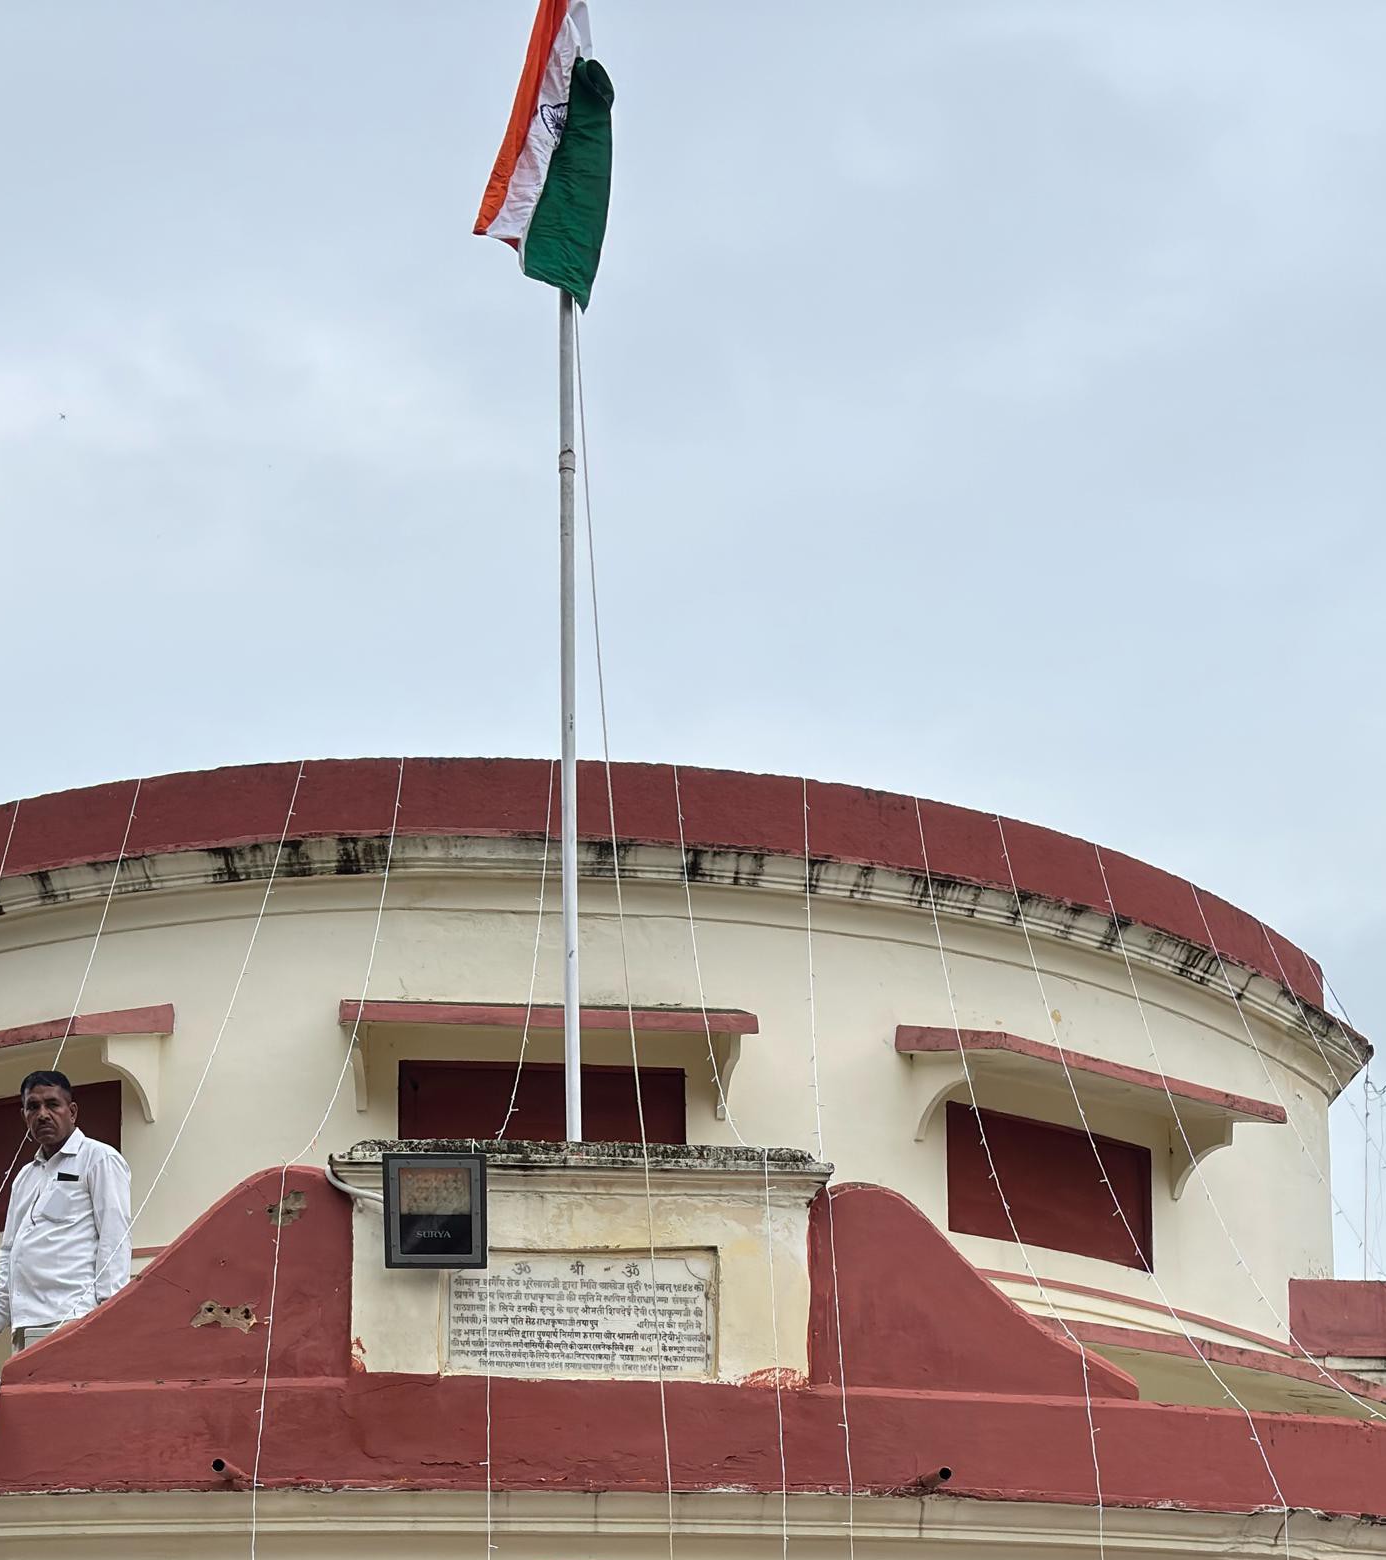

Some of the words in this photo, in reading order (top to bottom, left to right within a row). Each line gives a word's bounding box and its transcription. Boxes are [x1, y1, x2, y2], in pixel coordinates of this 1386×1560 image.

[414, 1230, 452, 1239] SURYA
[569, 1260, 585, 1276] श्री
[621, 1262, 640, 1278] ॐ
